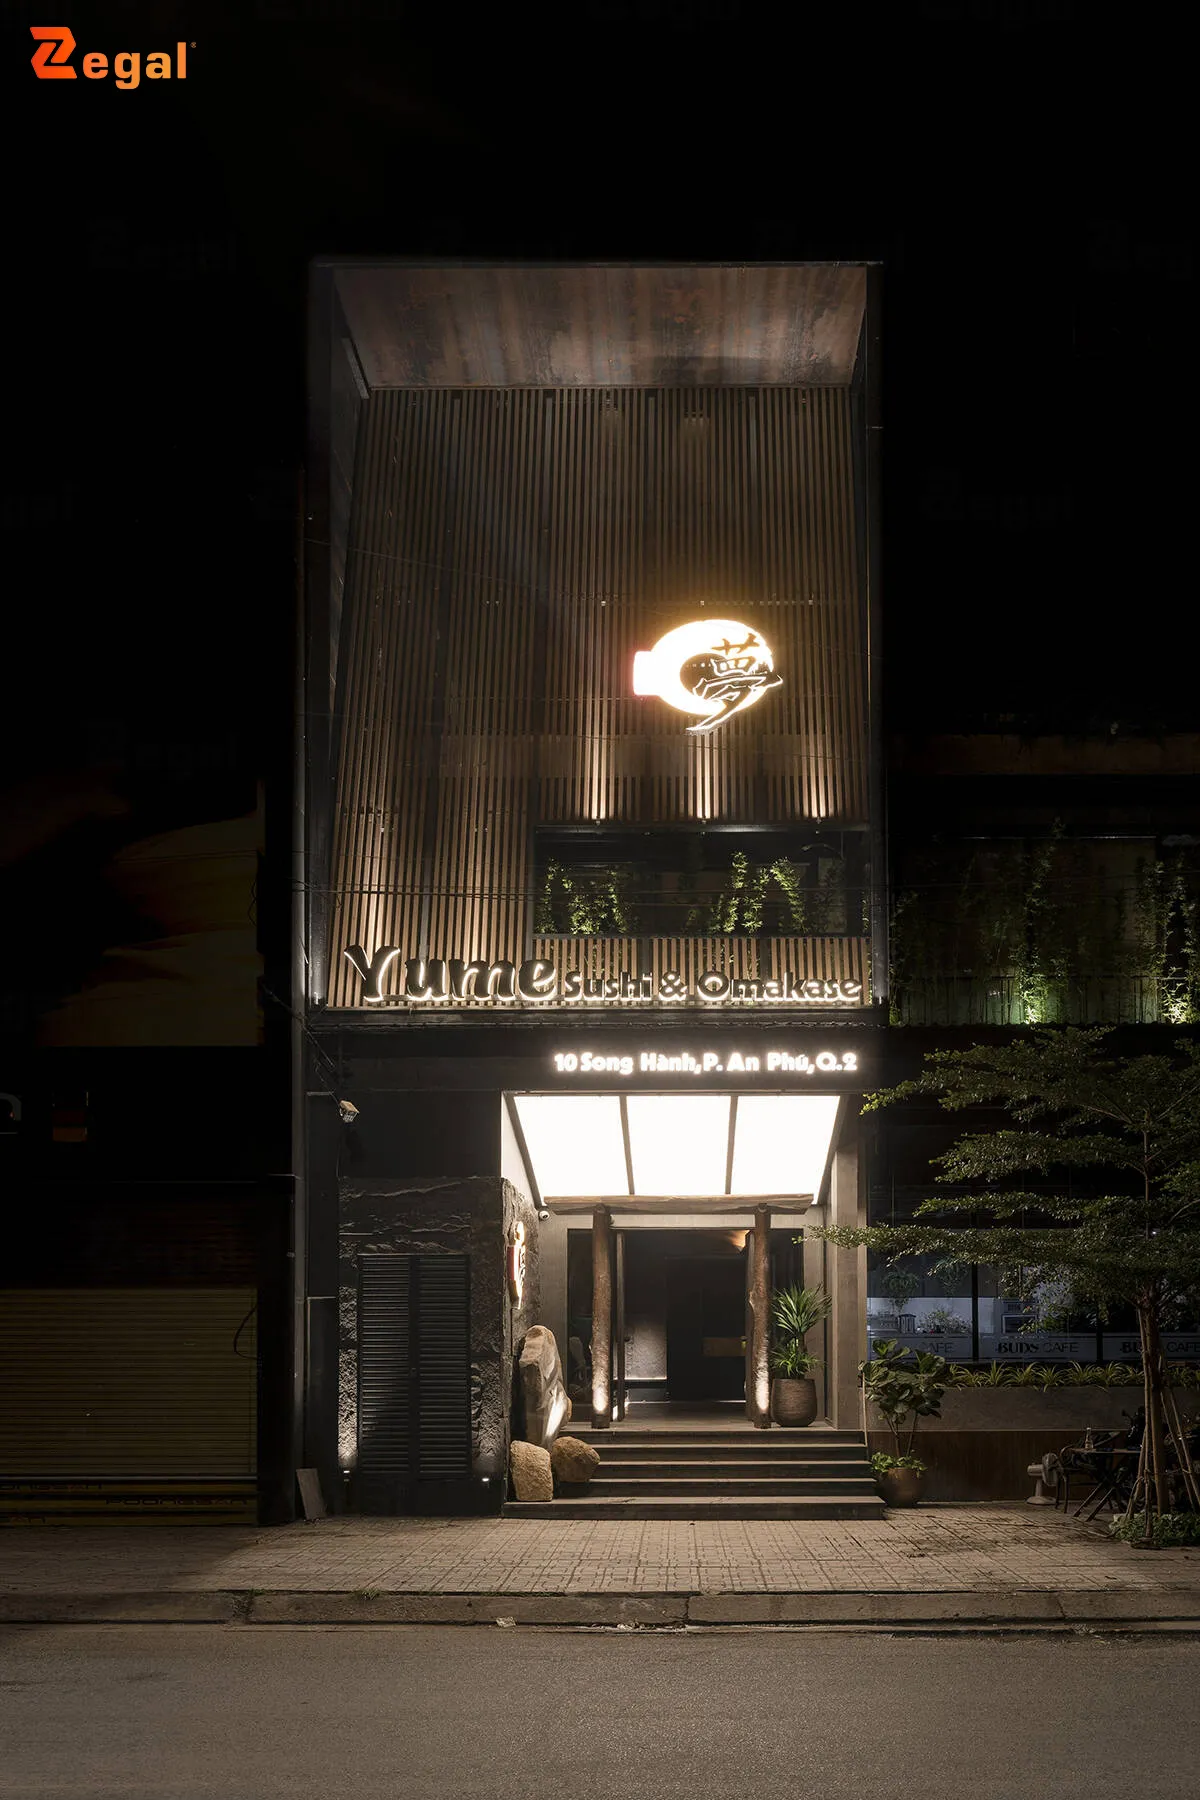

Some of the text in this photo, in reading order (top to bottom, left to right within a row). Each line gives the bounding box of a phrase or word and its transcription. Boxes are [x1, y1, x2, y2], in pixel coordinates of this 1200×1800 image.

[344, 944, 862, 1002] Yume Sushi & Omakase
[554, 1053, 578, 1072] 10
[580, 1052, 634, 1075] Song
[726, 1052, 760, 1072] An
[997, 1342, 1079, 1354] BUDS CAFE
